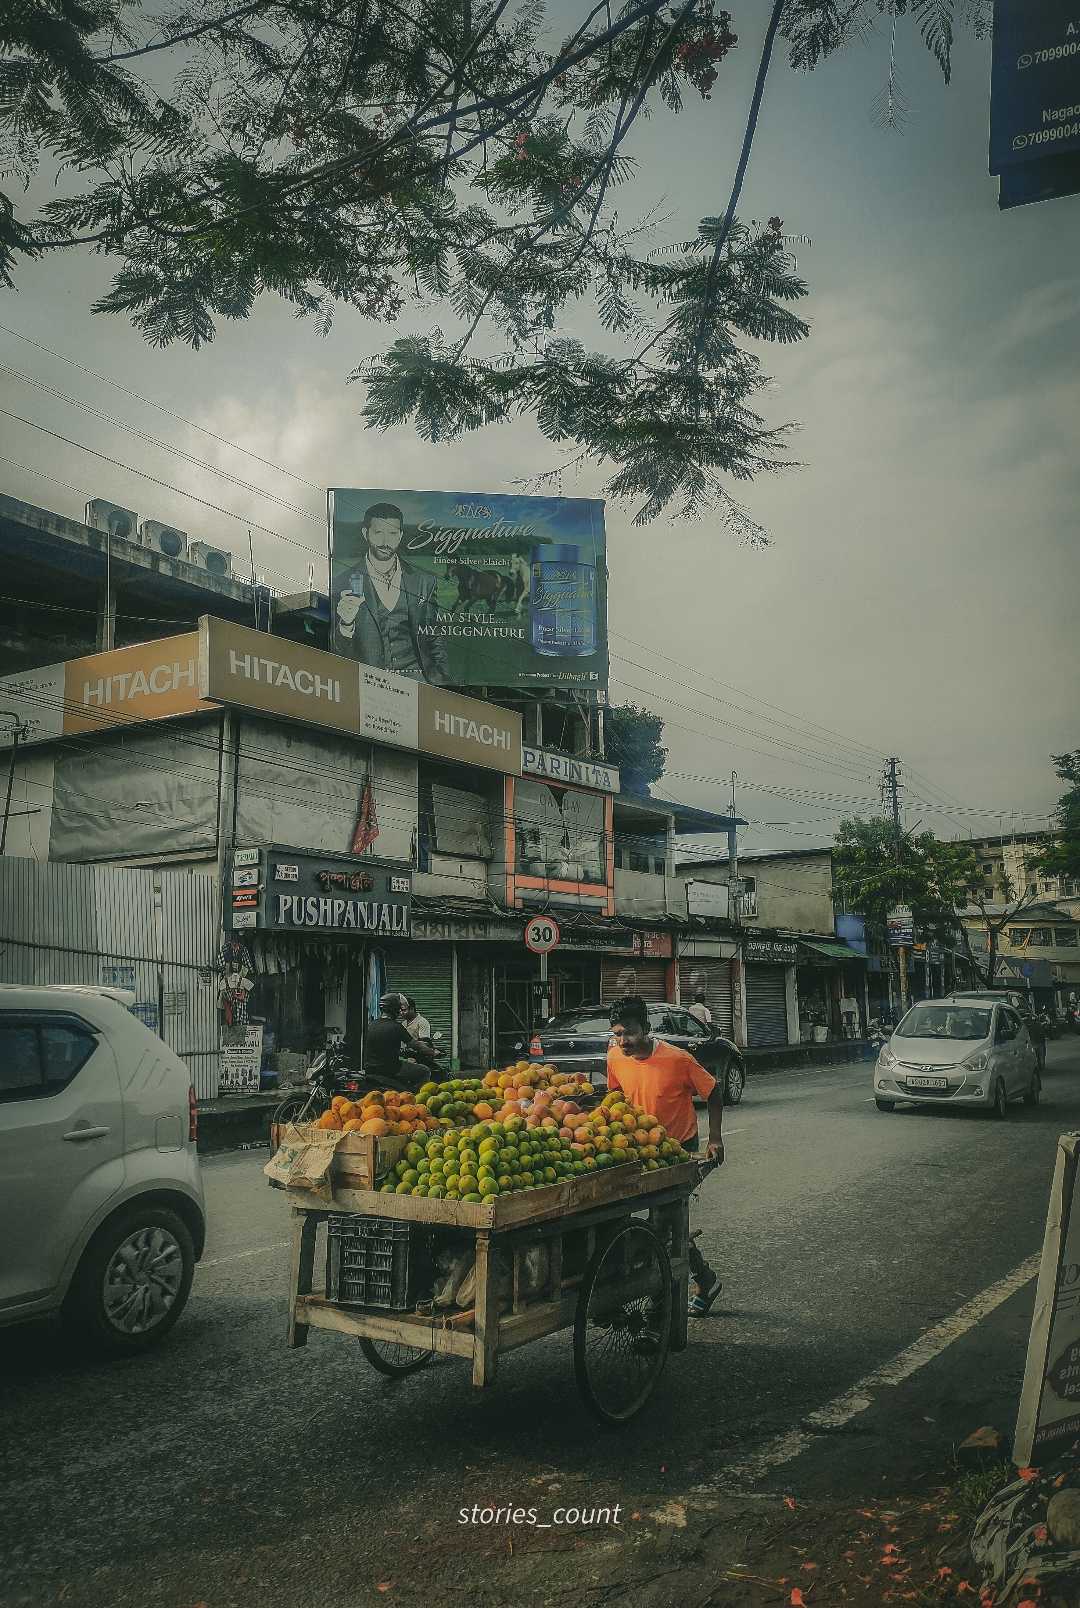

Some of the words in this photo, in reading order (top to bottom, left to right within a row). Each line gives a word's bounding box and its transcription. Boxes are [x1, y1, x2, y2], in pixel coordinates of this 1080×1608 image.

[408, 518, 538, 554] Siggnature
[417, 625, 437, 637] MY
[440, 626, 525, 639] SIGGNATURE
[436, 612, 455, 623] MY
[230, 648, 341, 704] HITACHI
[434, 710, 511, 751] HITACHI
[523, 750, 611, 787] PARINITA
[278, 894, 408, 931] PUSHPANJALI
[531, 926, 553, 943] 30
